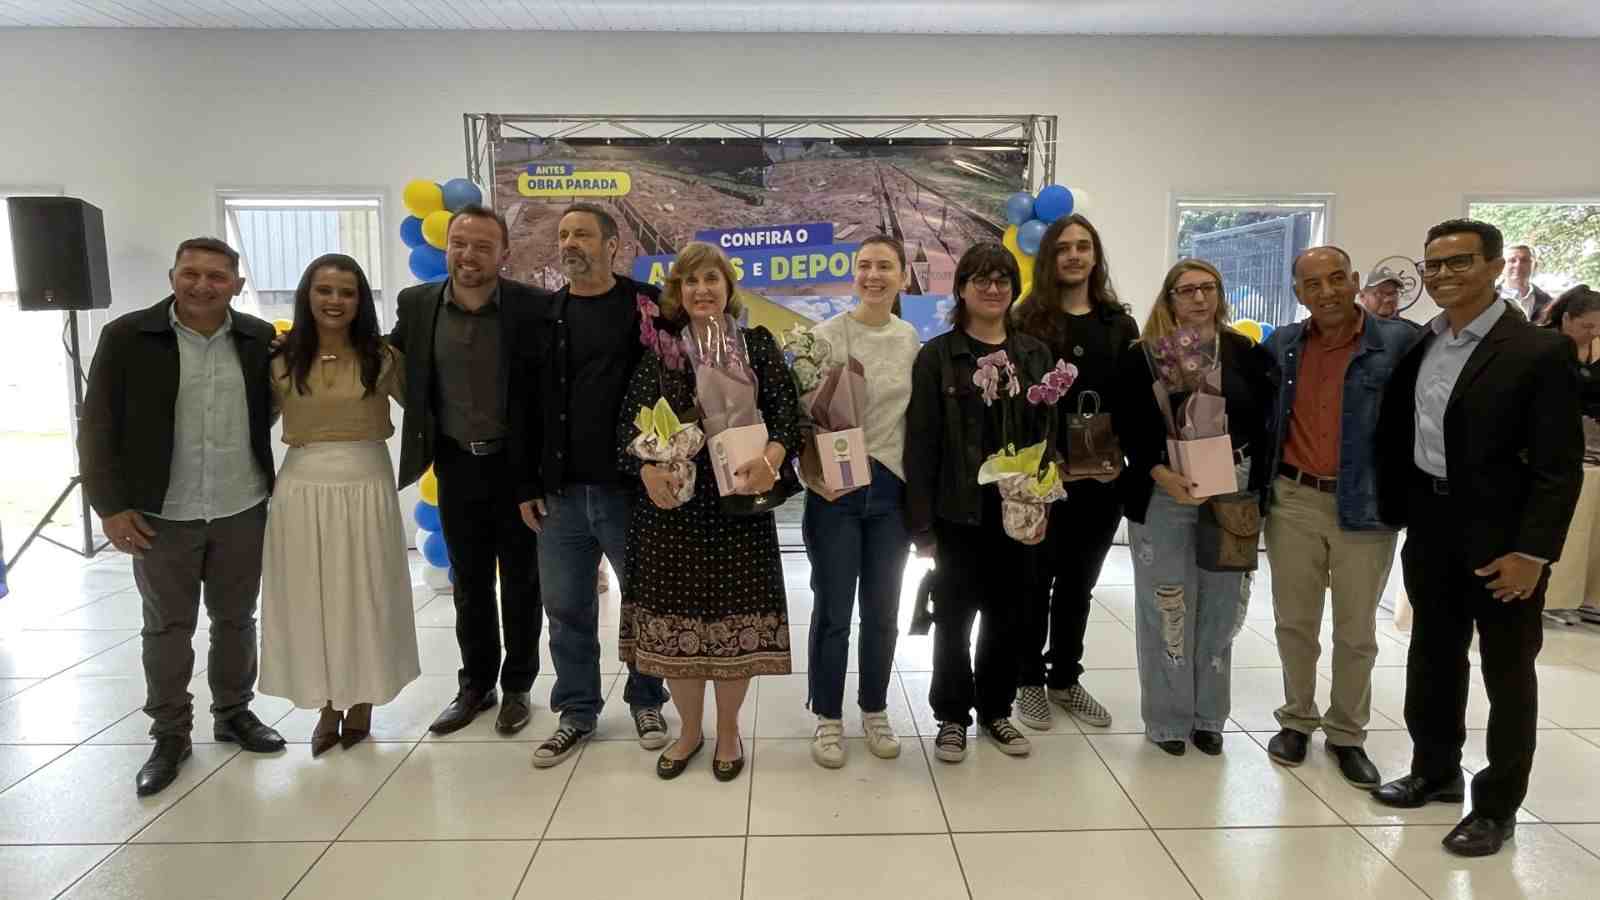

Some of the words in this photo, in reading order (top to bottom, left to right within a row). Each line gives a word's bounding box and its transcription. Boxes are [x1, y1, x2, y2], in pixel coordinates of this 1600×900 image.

[535, 165, 566, 175] ANTES
[527, 179, 563, 190] OBRA
[566, 179, 617, 190] PARADA
[720, 230, 792, 247] CONFIRA
[797, 229, 808, 243] O
[752, 262, 763, 276] E
